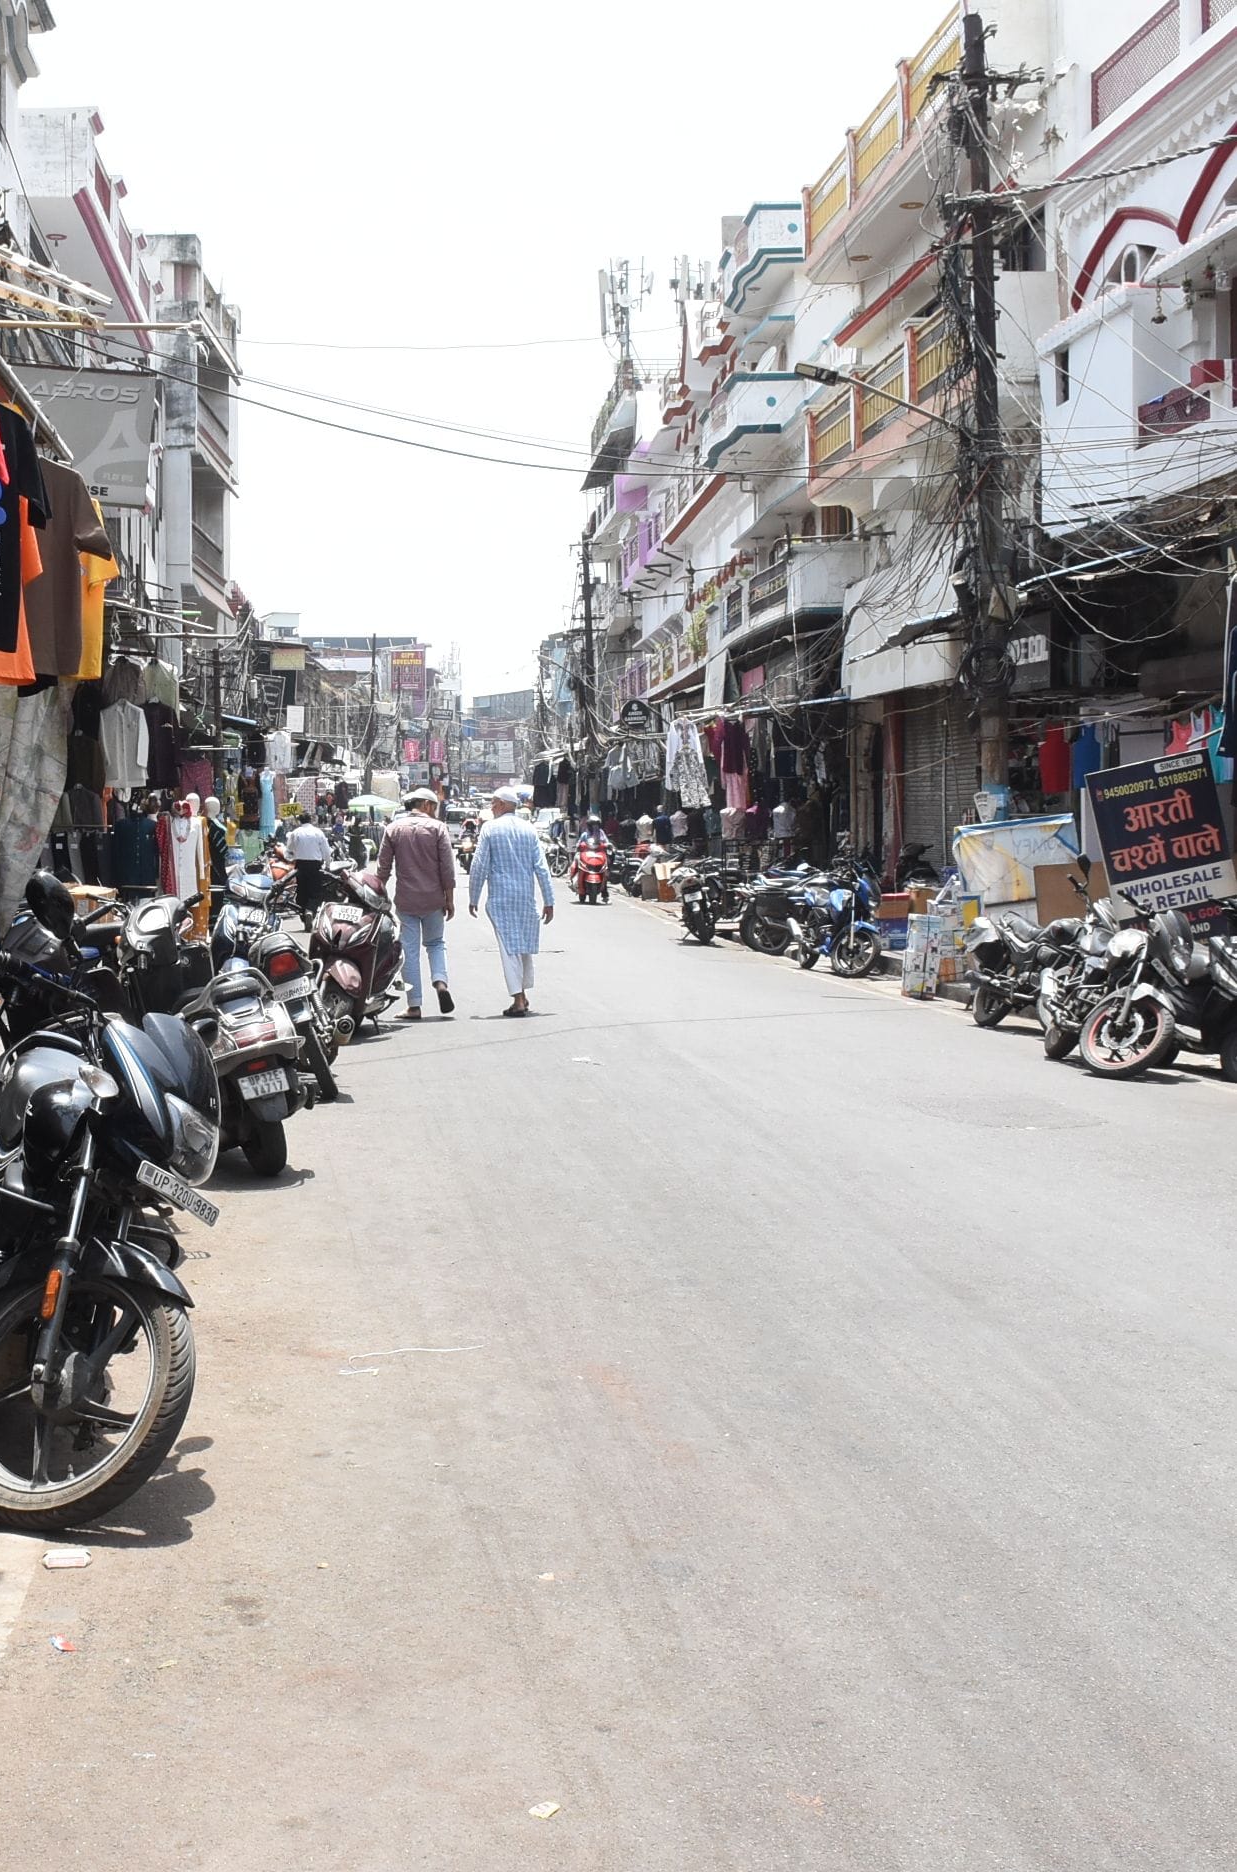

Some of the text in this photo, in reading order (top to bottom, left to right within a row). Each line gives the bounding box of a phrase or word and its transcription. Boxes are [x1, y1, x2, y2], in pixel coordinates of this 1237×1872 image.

[1160, 757, 1197, 771] SINCE 1957
[1104, 768, 1208, 799] 9450020972, 8318892971
[1123, 788, 1194, 832] आरती
[1170, 824, 1221, 860] वाले
[1124, 867, 1223, 898] WHOLESALE
[1157, 886, 1213, 911] RETAIL
